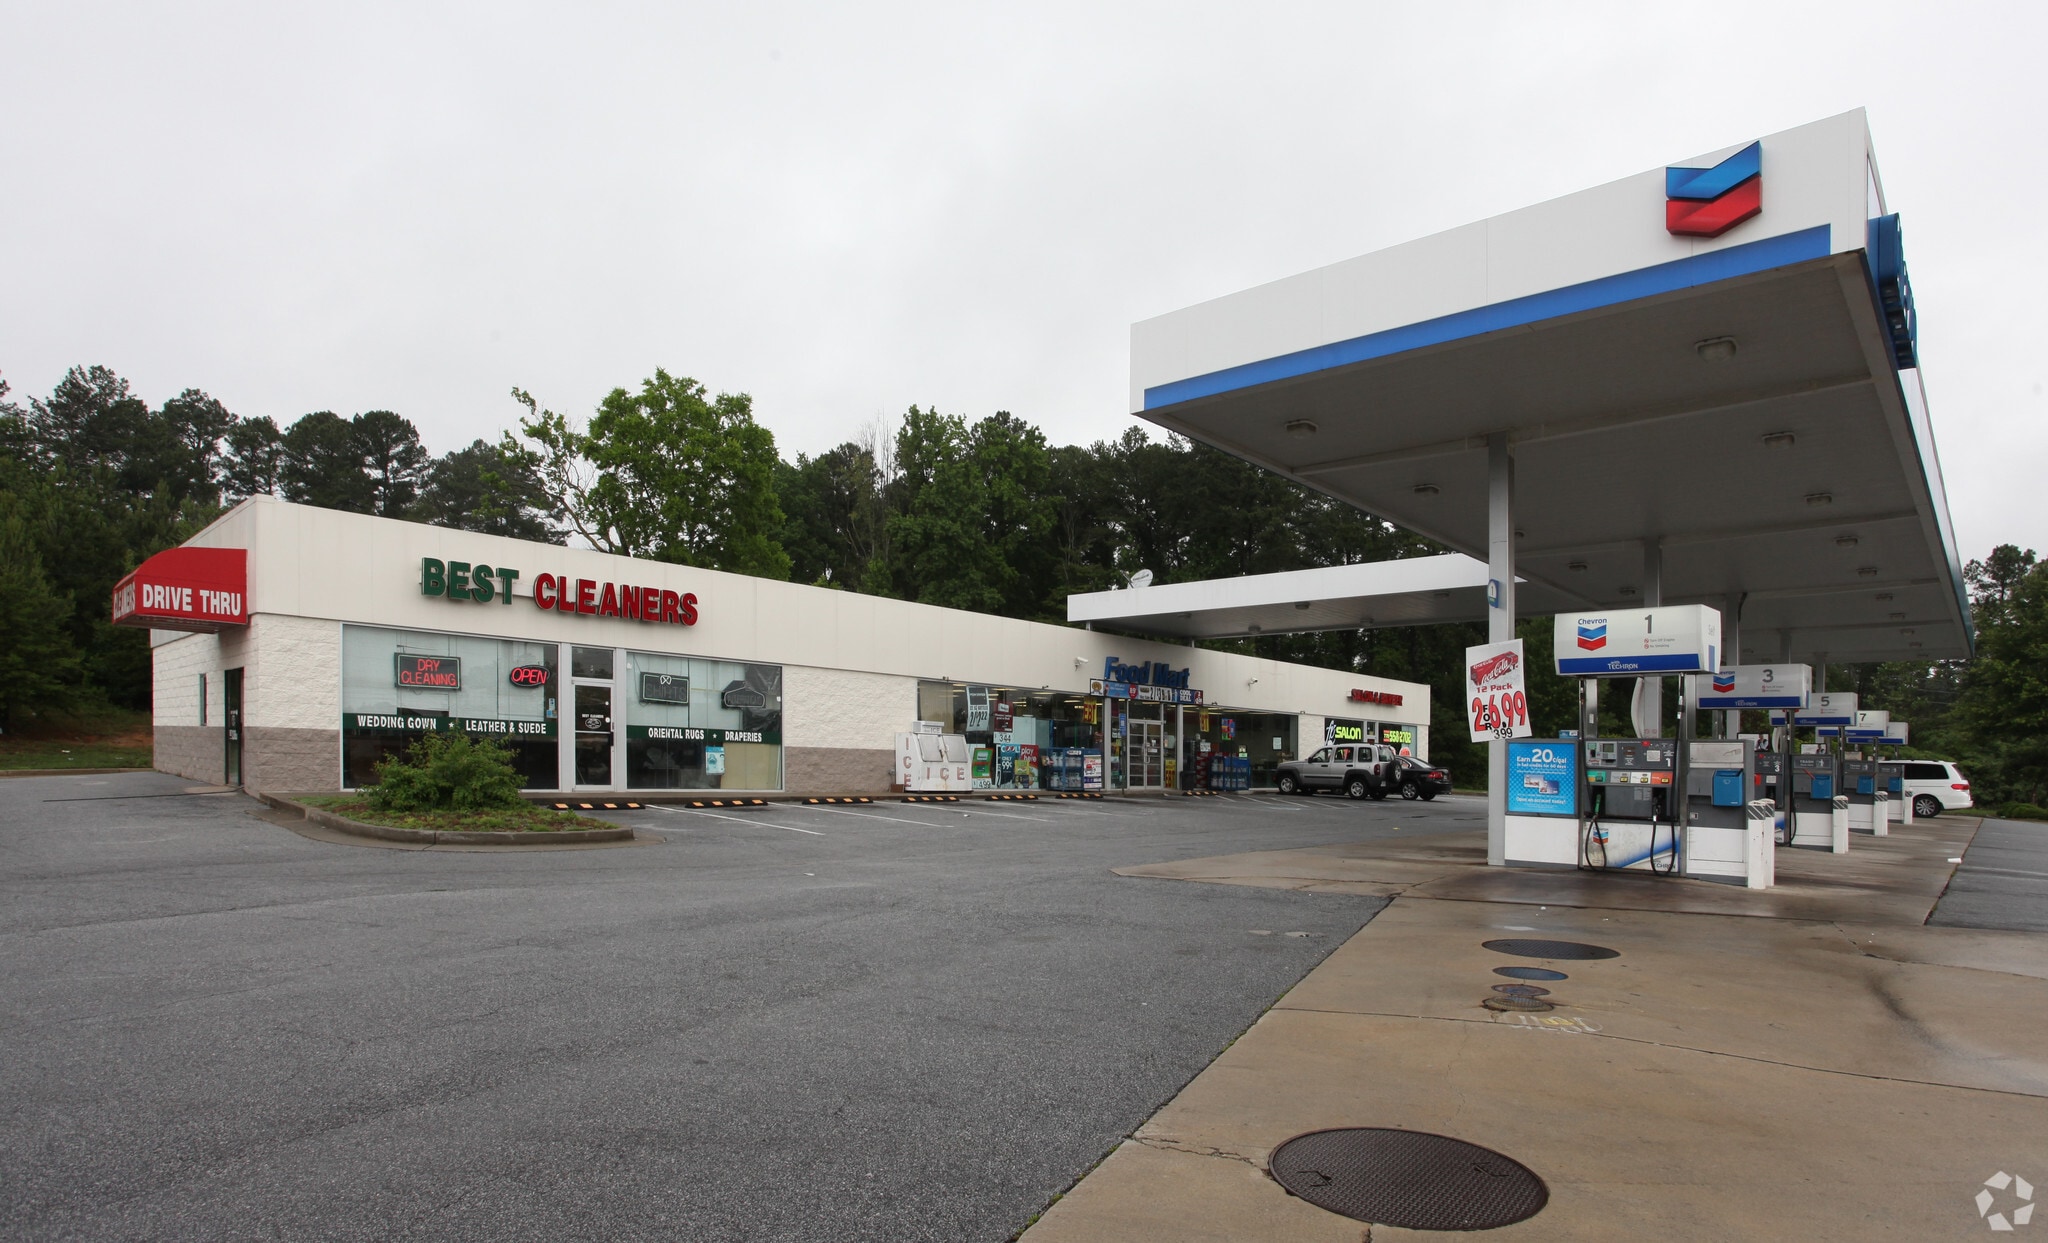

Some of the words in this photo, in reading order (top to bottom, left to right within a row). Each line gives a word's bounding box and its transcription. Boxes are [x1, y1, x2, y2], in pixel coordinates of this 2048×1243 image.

[420, 557, 519, 605] BEST
[533, 572, 698, 627] CLEANERS
[143, 584, 193, 612] DRIVE
[200, 589, 241, 616] THRU
[1644, 614, 1652, 634] 1
[417, 658, 440, 672] DRY
[1104, 656, 1151, 684] Food
[1153, 663, 1190, 688] Mart
[1608, 662, 1638, 671] TECHRON
[401, 670, 456, 686] CLEANING
[511, 667, 549, 684] OPEN
[1762, 669, 1774, 683] 3
[1490, 683, 1513, 691] Pack
[1820, 696, 1830, 707] 5
[1472, 697, 1486, 732] 2
[1859, 713, 1867, 721] 7
[357, 715, 404, 728] WEDDING
[407, 717, 437, 729] GOWN
[466, 720, 506, 733] LEATHER
[509, 722, 515, 733] &
[518, 723, 547, 734] SUEDE
[648, 728, 683, 739] ORIENTAL
[685, 729, 705, 740] RUGS
[725, 731, 762, 742] DRAPERIES
[1021, 747, 1035, 756] play
[1531, 749, 1553, 762] 20
[903, 737, 912, 788] ICE
[1665, 757, 1671, 768] 1
[1774, 765, 1780, 773] 3
[926, 766, 965, 781] ICE
